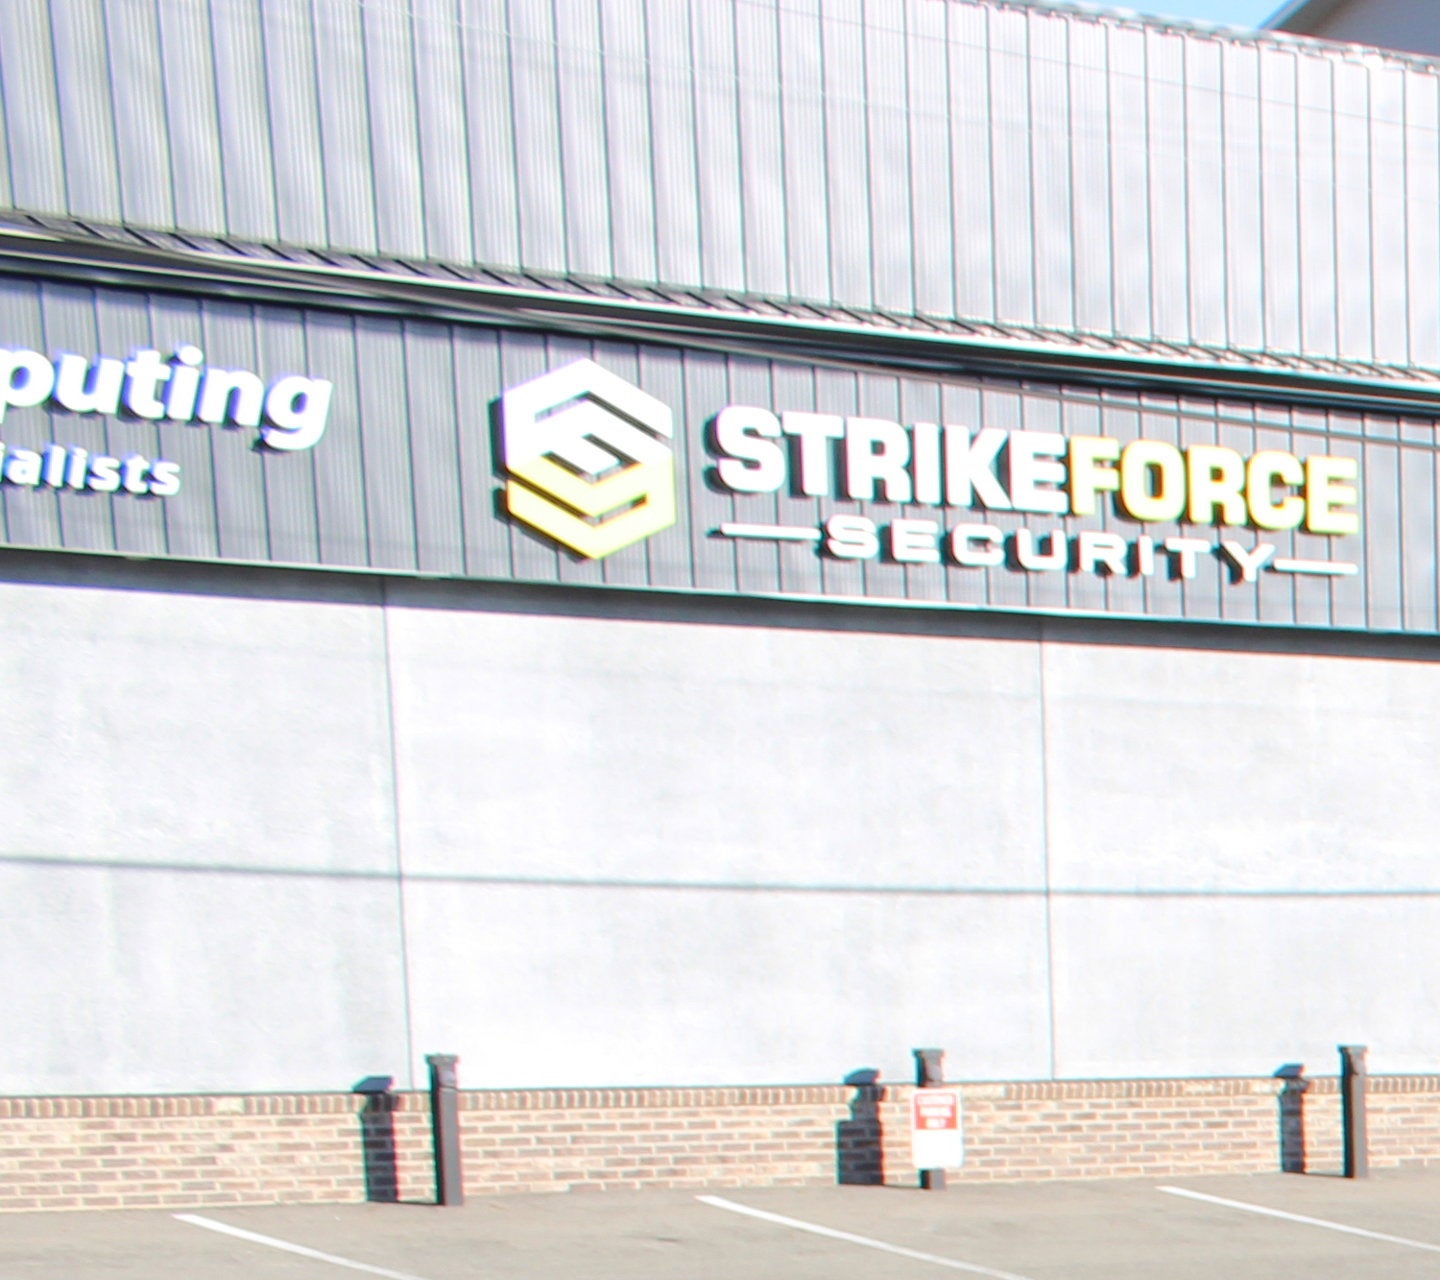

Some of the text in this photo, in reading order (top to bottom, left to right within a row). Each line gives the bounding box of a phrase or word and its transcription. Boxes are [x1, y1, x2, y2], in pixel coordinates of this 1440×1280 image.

[0, 440, 181, 496] alists
[716, 405, 1359, 535] STRIKEFORCE
[826, 513, 1276, 583] SECURITY
